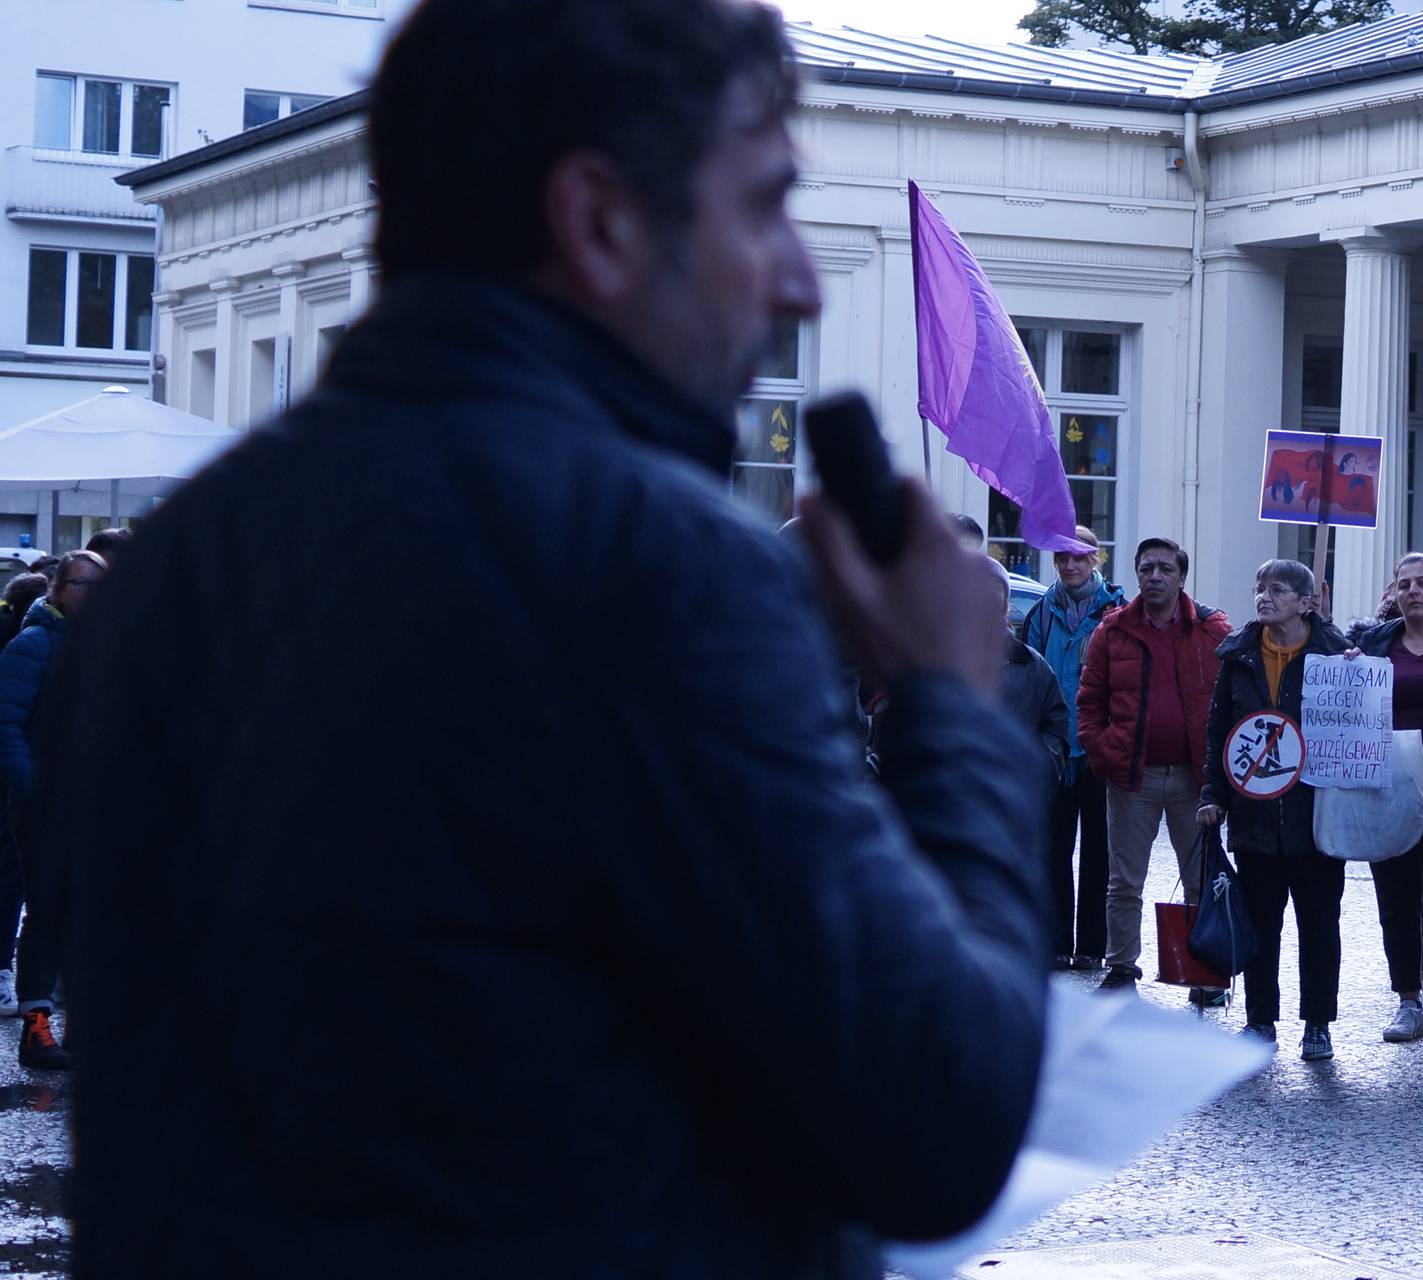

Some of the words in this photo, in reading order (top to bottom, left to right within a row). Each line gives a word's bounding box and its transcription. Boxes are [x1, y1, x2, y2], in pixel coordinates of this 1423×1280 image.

[1304, 663, 1388, 689] GEMEINSAM
[1316, 690, 1364, 707] GEGEN
[1306, 708, 1385, 730] RASSISMUS
[1306, 739, 1392, 762] POLIZEIGEWALT
